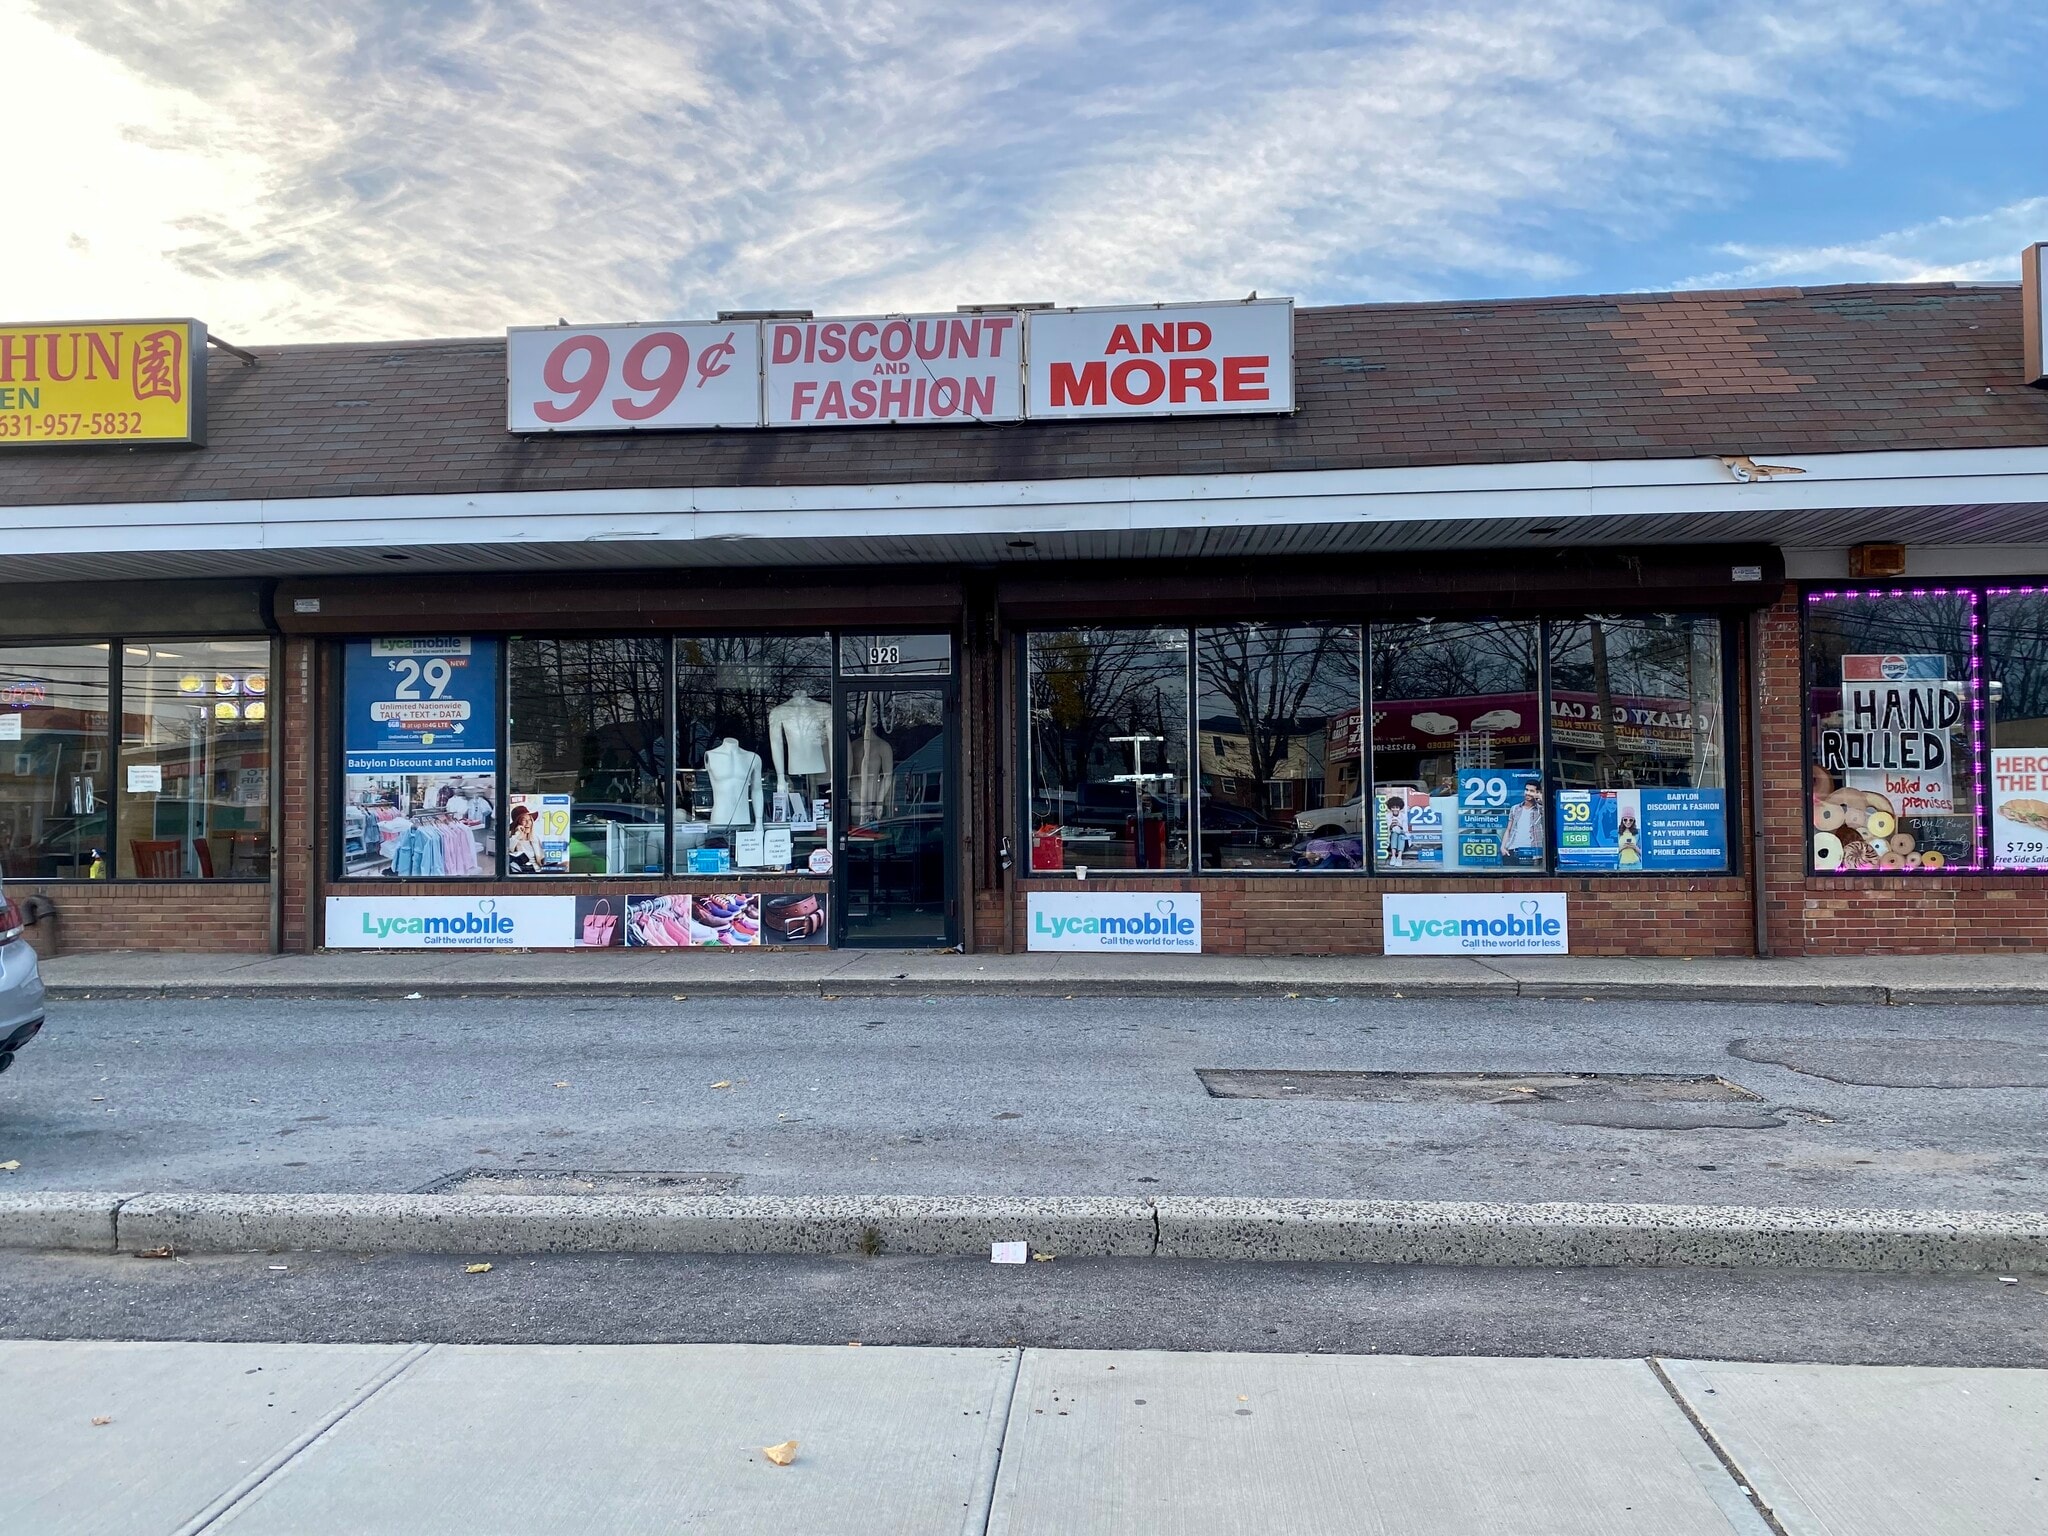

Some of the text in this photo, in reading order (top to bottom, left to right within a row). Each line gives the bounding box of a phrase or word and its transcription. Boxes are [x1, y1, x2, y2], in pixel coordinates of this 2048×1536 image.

[772, 318, 1013, 364] DISCOUNT
[1104, 321, 1212, 355] AND
[0, 331, 124, 382] HUN
[133, 329, 183, 403] 園
[533, 331, 736, 423] 99¢
[872, 362, 910, 376] AND
[1050, 355, 1270, 407] MORE
[0, 387, 40, 409] EN
[790, 375, 996, 420] FASHION
[0, 412, 142, 436] 631-957-5832
[871, 647, 898, 663] 928
[440, 710, 462, 718] DATA
[1853, 688, 1961, 730] HAND
[1822, 731, 1945, 770] ROLLED
[348, 757, 494, 769] Babylon Discount and Fashion
[1885, 774, 1941, 794] baked on
[1996, 775, 2036, 792] THE
[1647, 803, 1681, 811] DISCOUNT
[1902, 796, 1953, 816] premises
[543, 810, 569, 836] 19
[1375, 794, 1389, 859] Unlimited
[1910, 819, 1934, 833] Buy
[1465, 844, 1495, 855] 6GB
[1676, 848, 1721, 856] ACCESSORIES
[2013, 855, 2030, 863] Side
[362, 912, 514, 938] Lycamobile
[1035, 911, 1195, 938] Lycamobile
[1392, 913, 1561, 941] Lycamobile
[424, 936, 514, 944] Call the world for less
[1100, 936, 1195, 946] Call the world for less
[1462, 939, 1561, 948] Call the world for less
